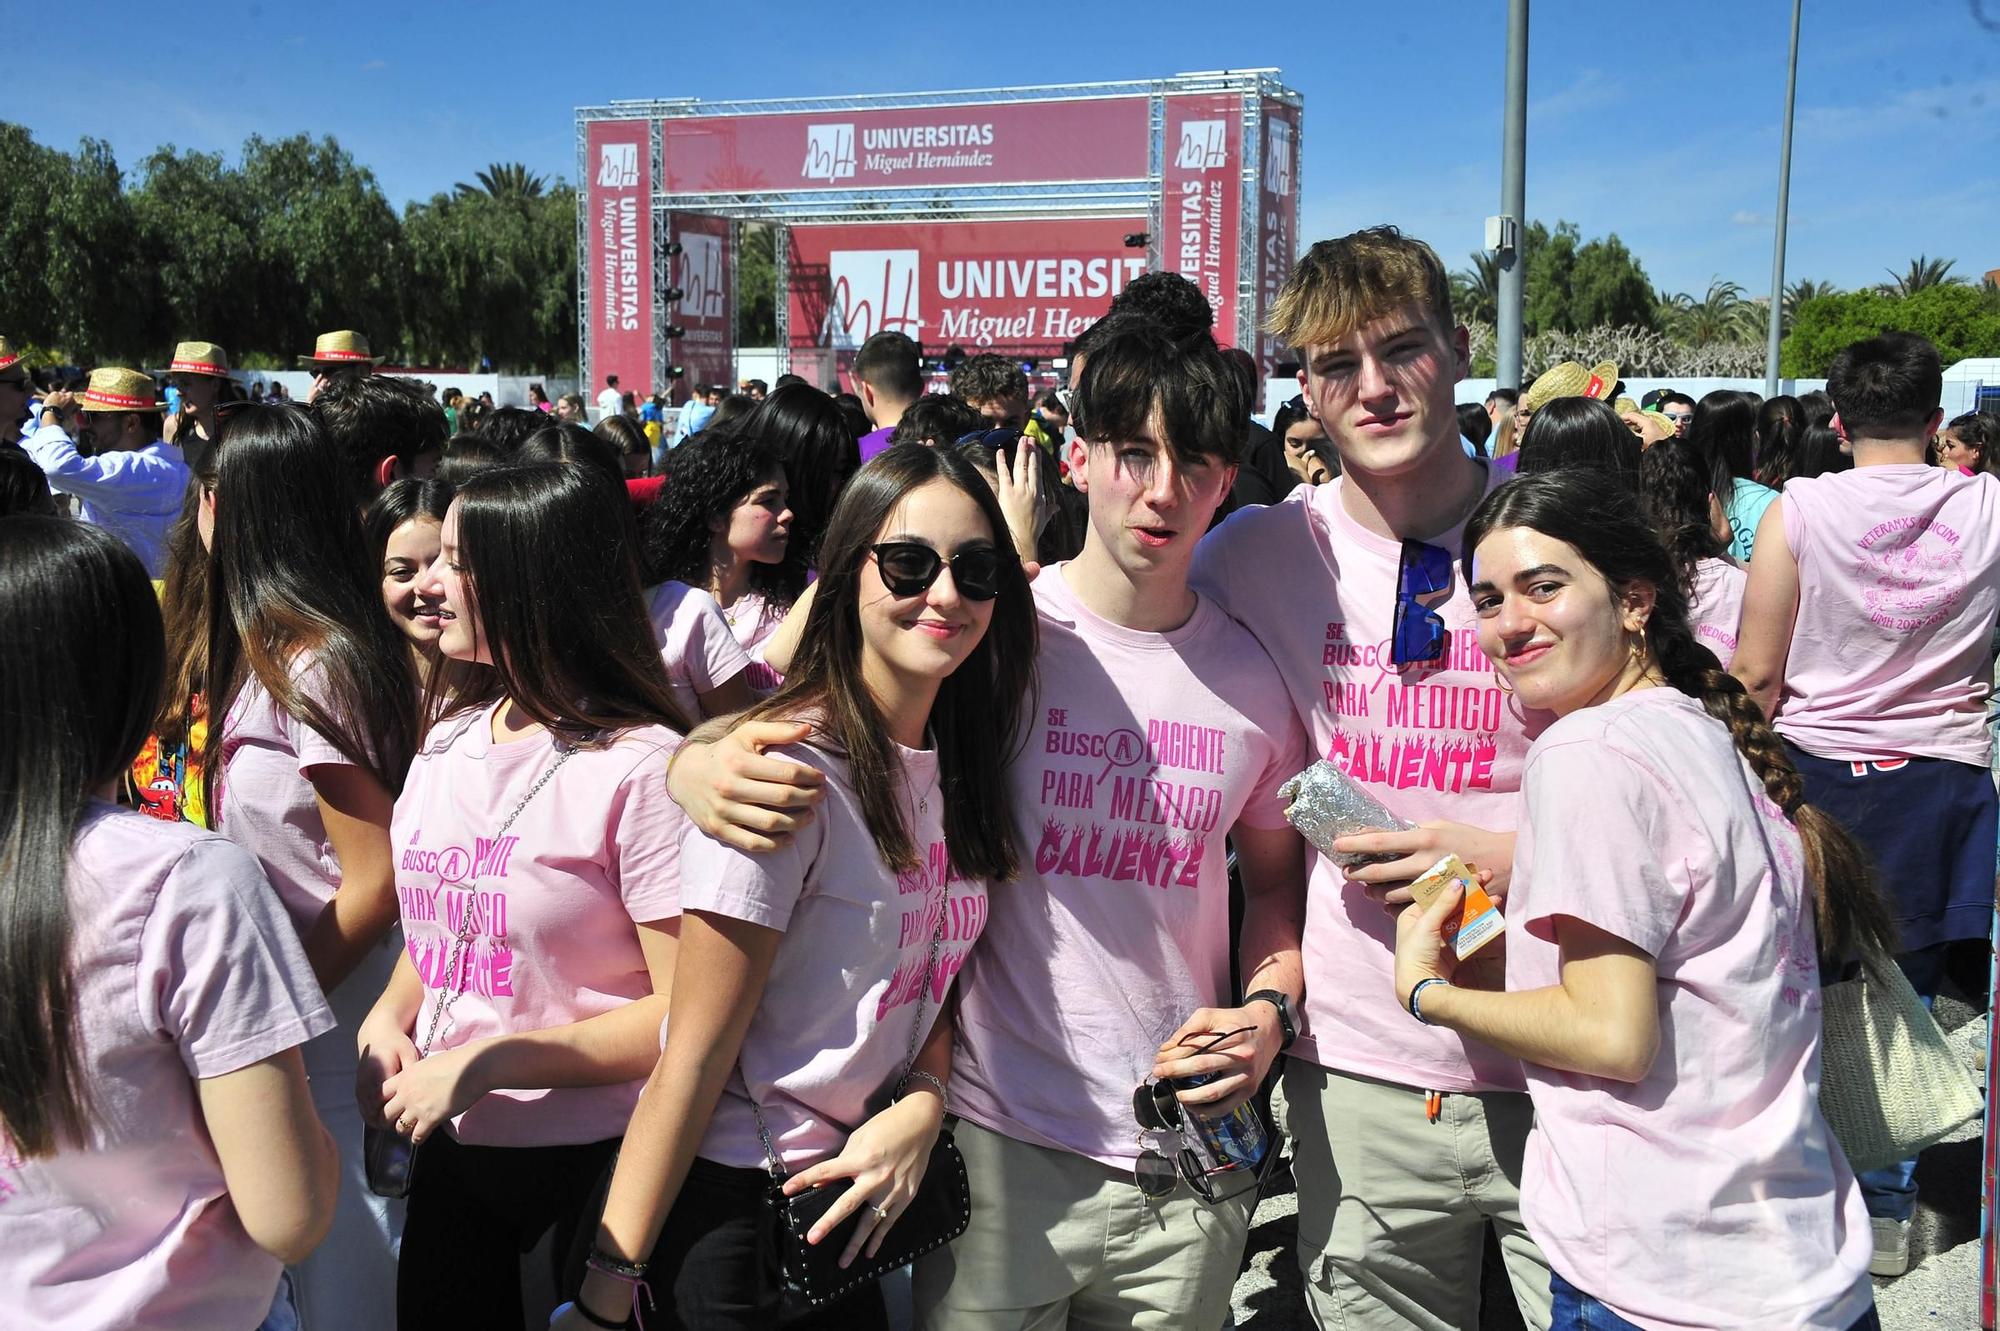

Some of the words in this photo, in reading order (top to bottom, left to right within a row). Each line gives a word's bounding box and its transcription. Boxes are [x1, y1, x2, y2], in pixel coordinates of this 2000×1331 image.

[863, 124, 994, 149] UNIVERSITAS
[864, 152, 913, 175] Miguel
[917, 150, 993, 168] Hernández
[600, 199, 617, 249] Miguel
[1205, 180, 1222, 267] Hernández
[620, 197, 638, 330] UNIVERSITAS
[938, 258, 1147, 299] UNIVERSIT
[605, 253, 619, 330] Hernández
[938, 307, 1036, 347] Miguel
[1857, 516, 1915, 549] VETERANXS
[1326, 622, 1345, 640] SE
[1871, 612, 1894, 629] UMH
[1323, 681, 1369, 717] PARA
[1048, 708, 1068, 727] SE
[1045, 730, 1136, 763] BUSCA
[1146, 719, 1226, 775] PACIENTE
[1041, 770, 1093, 809] PARA
[1109, 766, 1223, 833] MÉDICO
[402, 848, 462, 876] BUSCA
[1036, 813, 1207, 889] CALIENTE
[401, 886, 436, 921] PARA
[1445, 921, 1458, 932] 50
